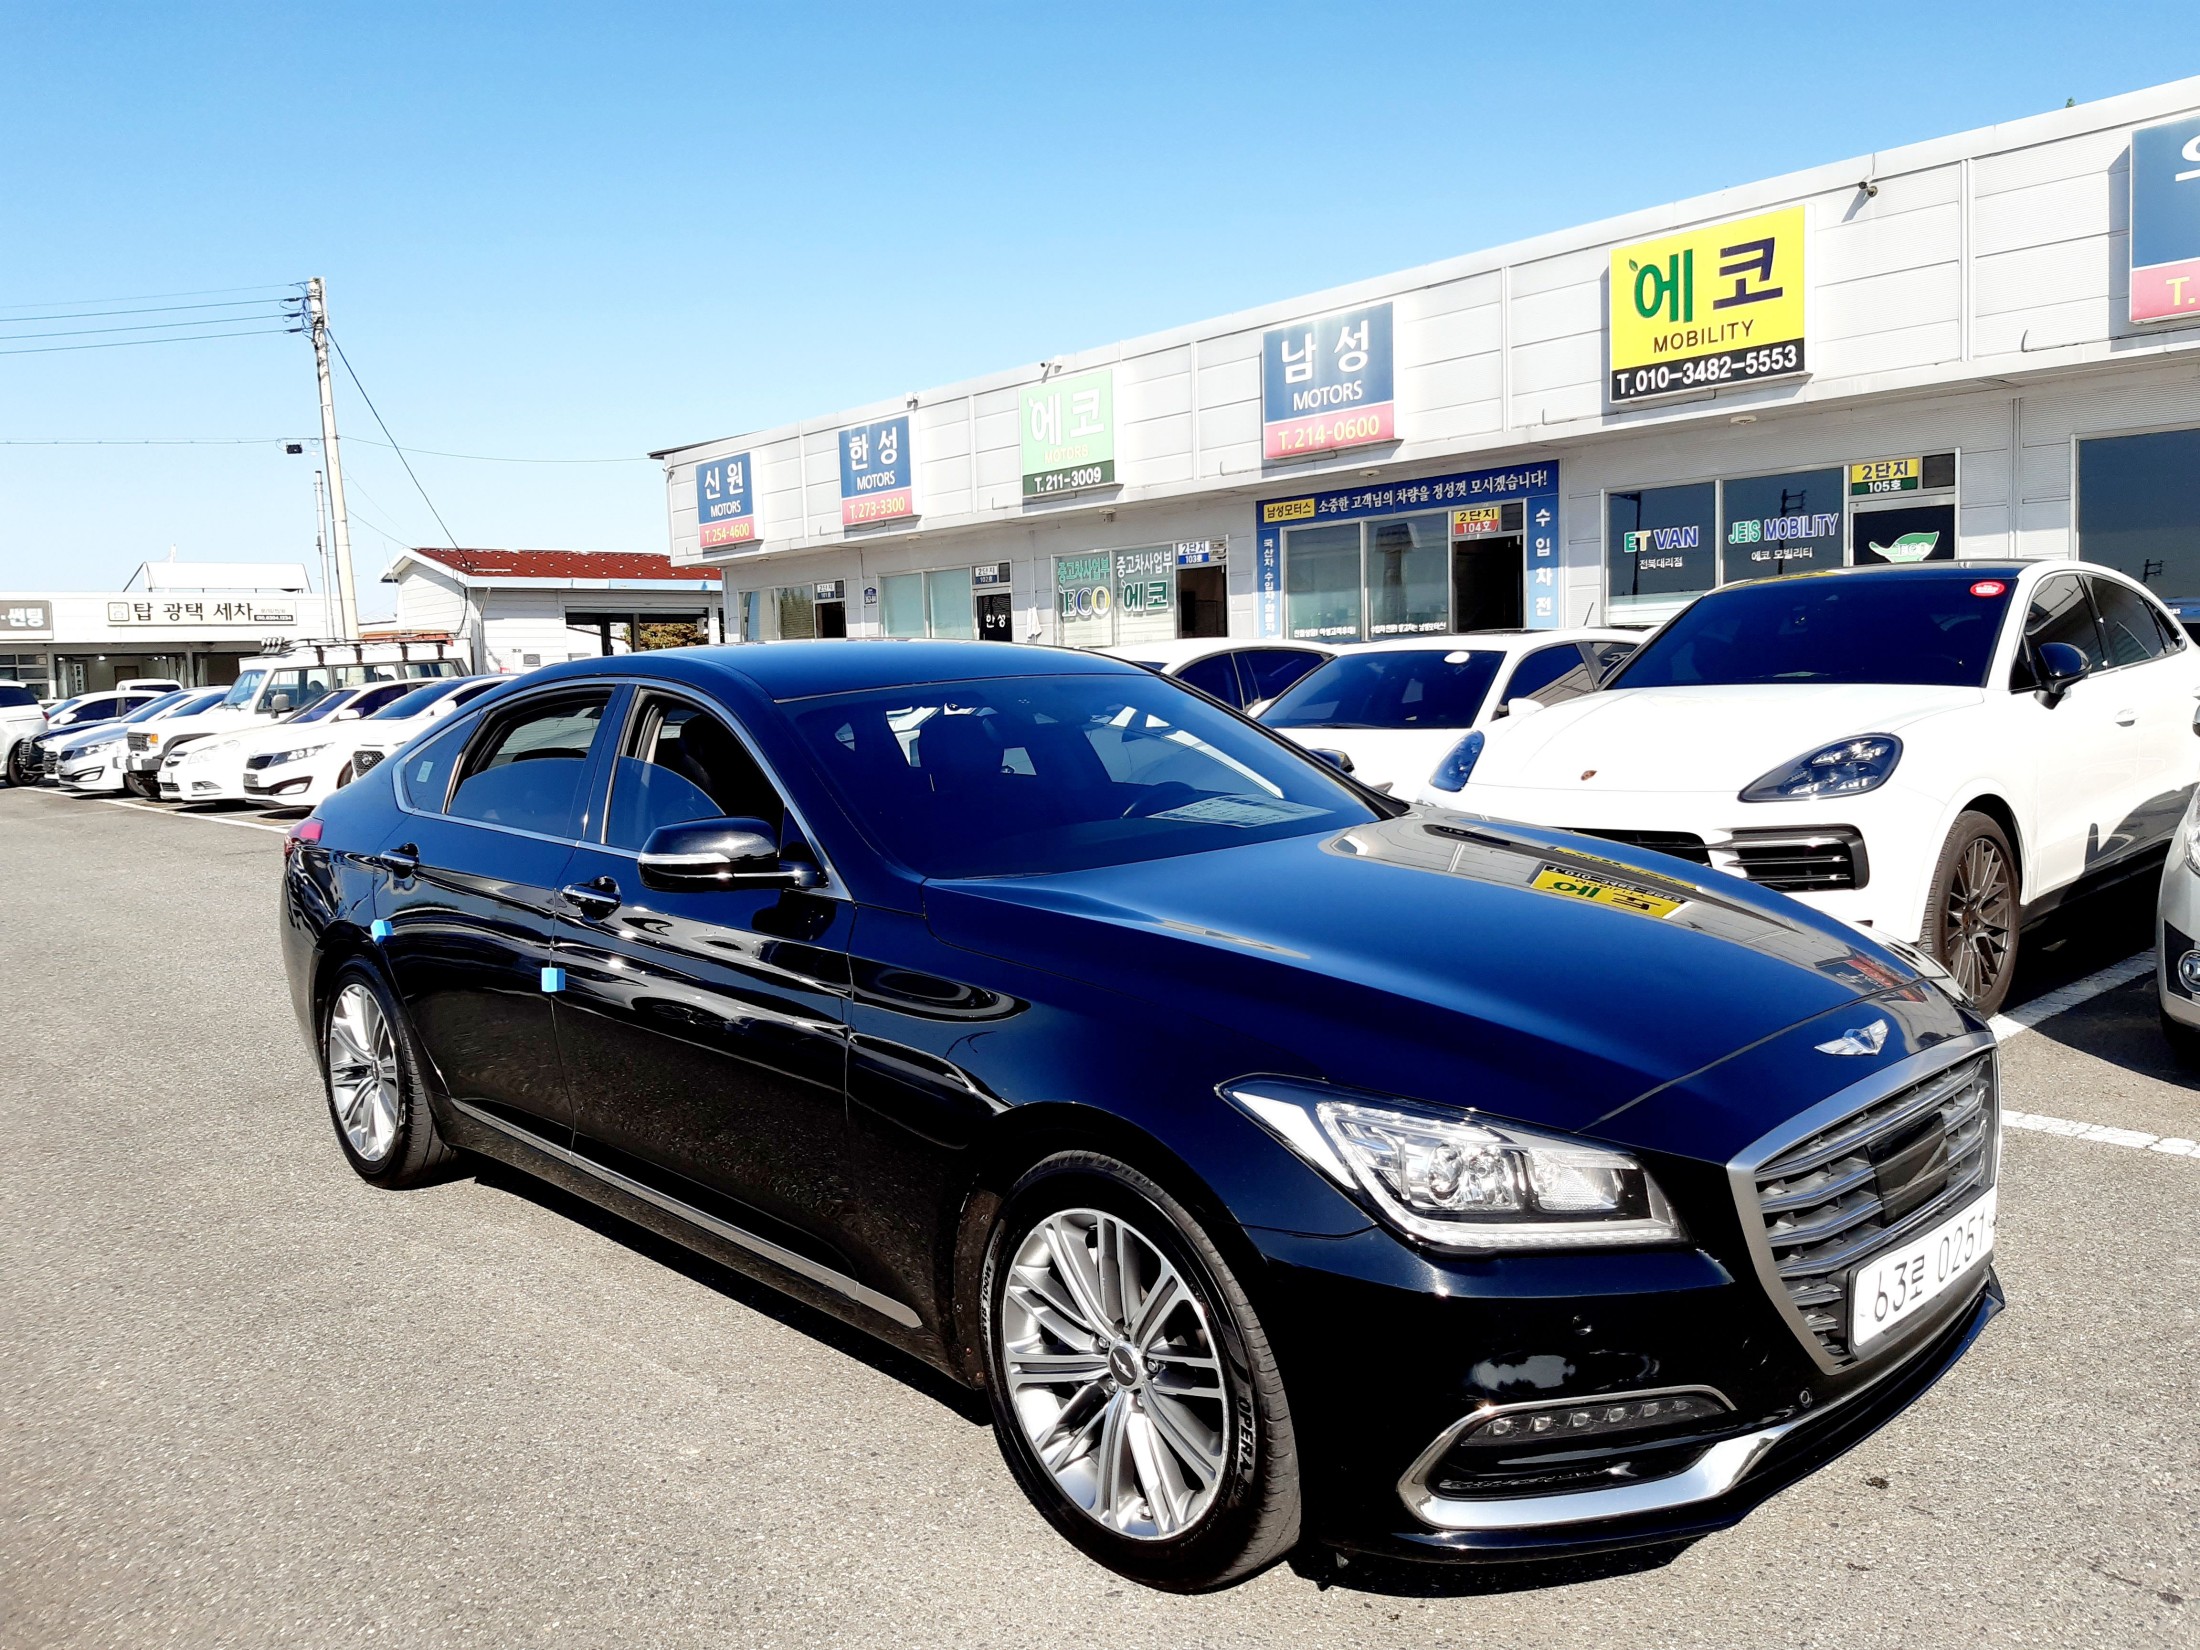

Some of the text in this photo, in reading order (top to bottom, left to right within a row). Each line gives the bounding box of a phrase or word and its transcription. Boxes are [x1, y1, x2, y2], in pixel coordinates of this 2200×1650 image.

[1653, 319, 1754, 353] MOBILITY
[1280, 319, 1369, 385] 남성
[1616, 344, 1797, 396] T.010-3482-5553
[1292, 379, 1363, 411] MOTORS
[1278, 415, 1380, 451] T.214-0600
[848, 426, 898, 471] 한성
[1044, 443, 1089, 465] MOTORS
[704, 461, 744, 500] 신원
[856, 470, 895, 491] MOTORS
[1034, 466, 1102, 492] T.211-3009
[1862, 460, 1909, 481] 2단지
[1267, 502, 1312, 519] 남성모터스
[1318, 499, 1349, 514] 소중한
[1351, 492, 1393, 510] 고객님의
[1396, 485, 1430, 505] 차량을
[1470, 470, 1548, 494] 모시겠습니다!
[1868, 479, 1902, 493] 105호
[710, 500, 742, 518] MOTORS
[849, 496, 905, 520] T.273-3300
[1459, 508, 1495, 522] 2단지
[705, 523, 750, 544] T.254-4600
[1462, 520, 1491, 533] 104호
[1623, 525, 1699, 553] ET VAN
[1728, 512, 1840, 545] JEIS MOBILITY
[1181, 541, 1206, 554] 2단지
[1751, 547, 1813, 561] 에코 모빌리티
[1116, 550, 1173, 579] 중고차사업부
[1640, 556, 1683, 570] 전북대리점
[1061, 585, 1111, 617] ECO
[1122, 579, 1168, 612] 에코
[133, 602, 253, 621] 탑 광택 세차
[1937, 1206, 1986, 1283] 0251
[1238, 1396, 1254, 1475] OPERA
